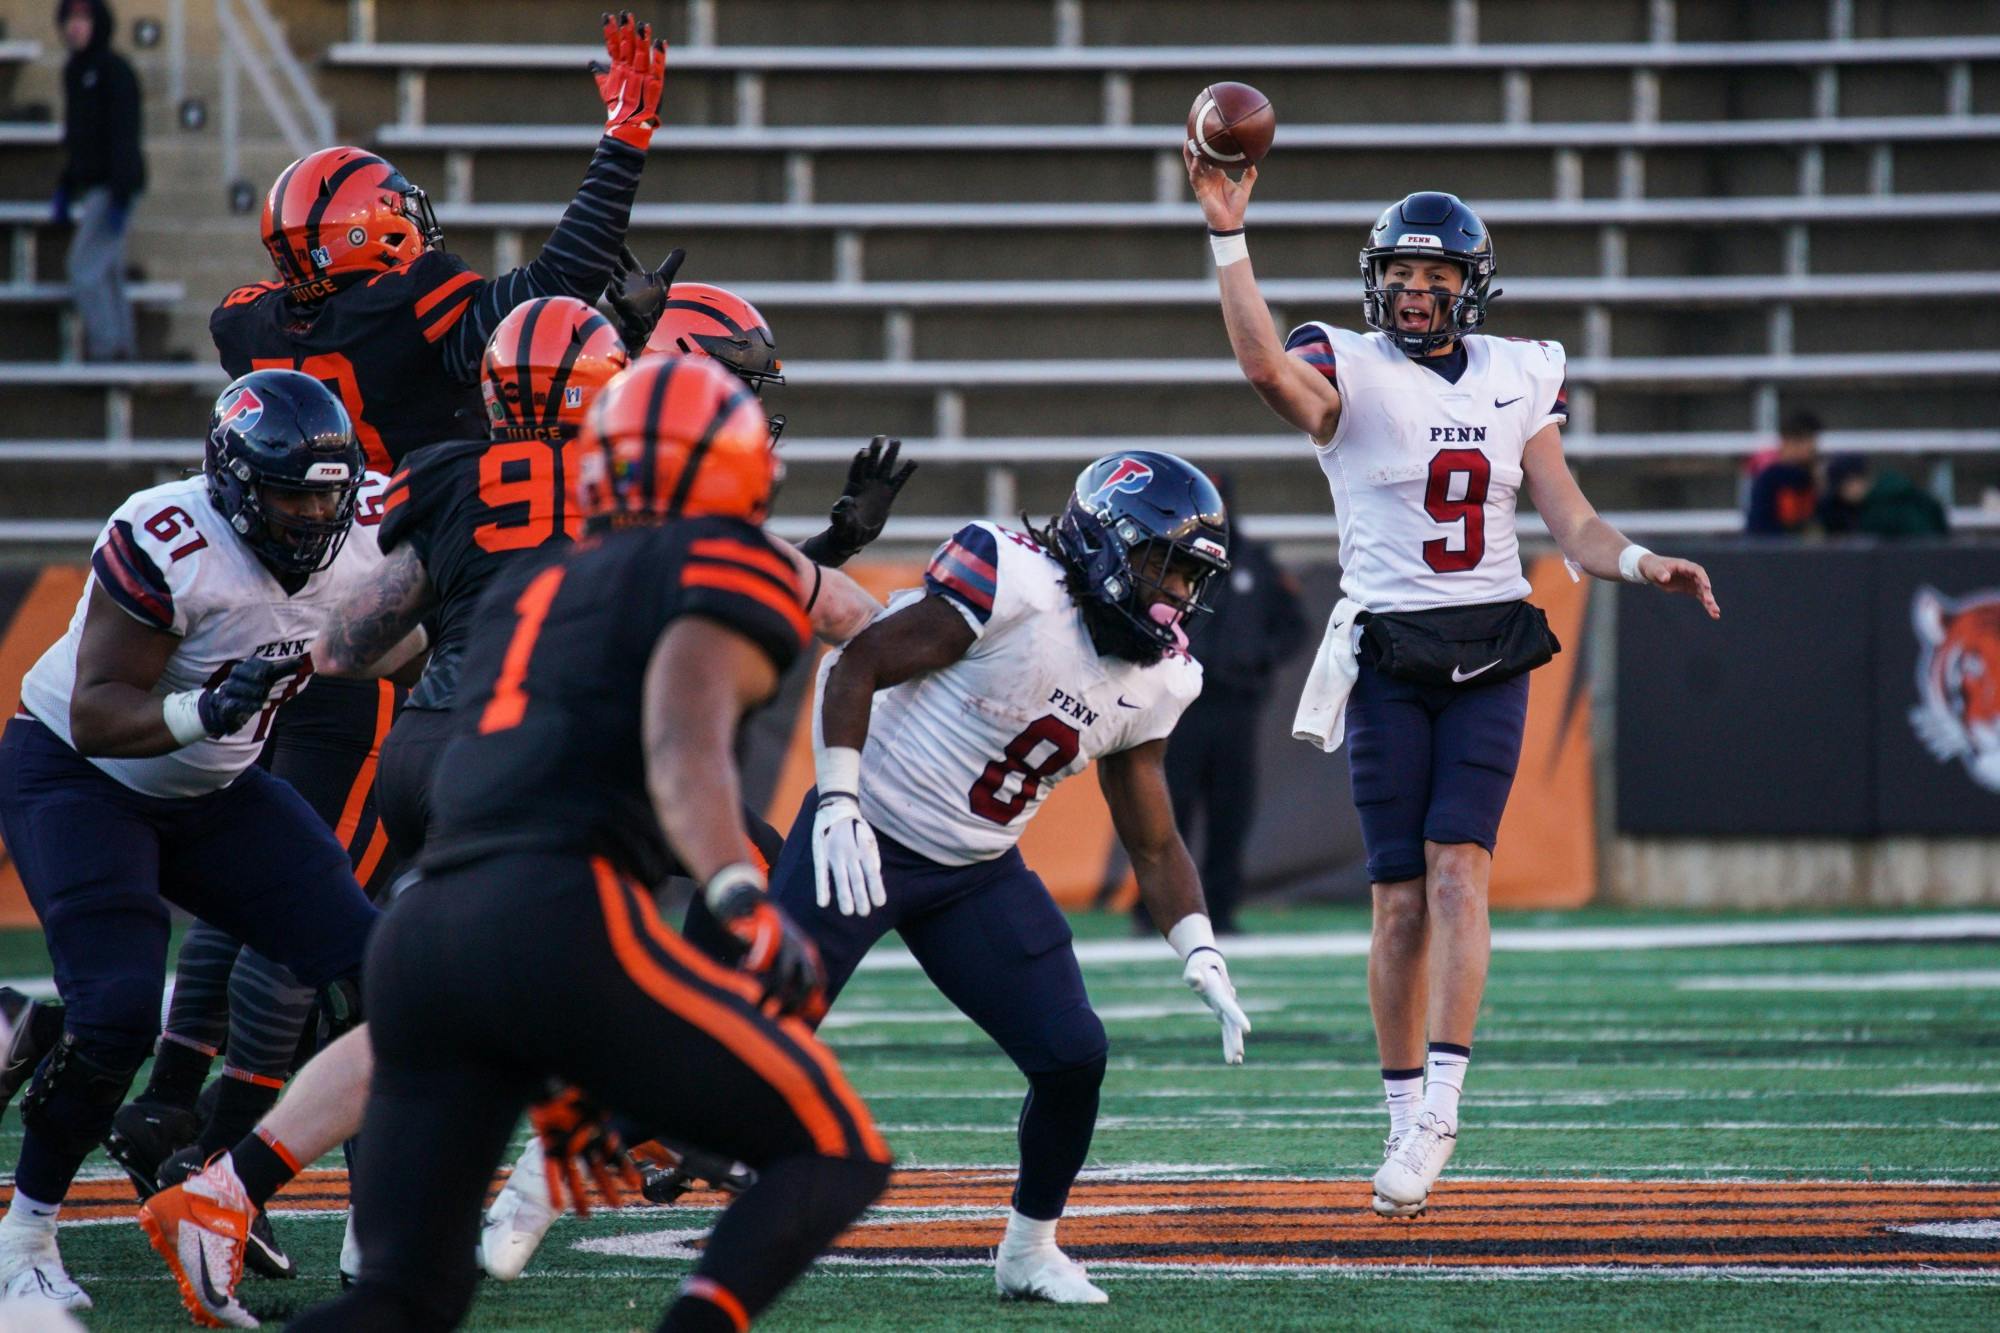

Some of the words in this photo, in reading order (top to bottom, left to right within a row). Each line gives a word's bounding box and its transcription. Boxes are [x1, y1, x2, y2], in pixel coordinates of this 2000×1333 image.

[1407, 236, 1431, 244] PENN
[1429, 426, 1487, 442] PENN
[144, 505, 209, 564] 61
[1422, 447, 1492, 574] 9
[251, 638, 315, 659] PENN
[477, 564, 567, 736] 1
[1048, 688, 1099, 727] PENN
[967, 713, 1081, 827] 8
